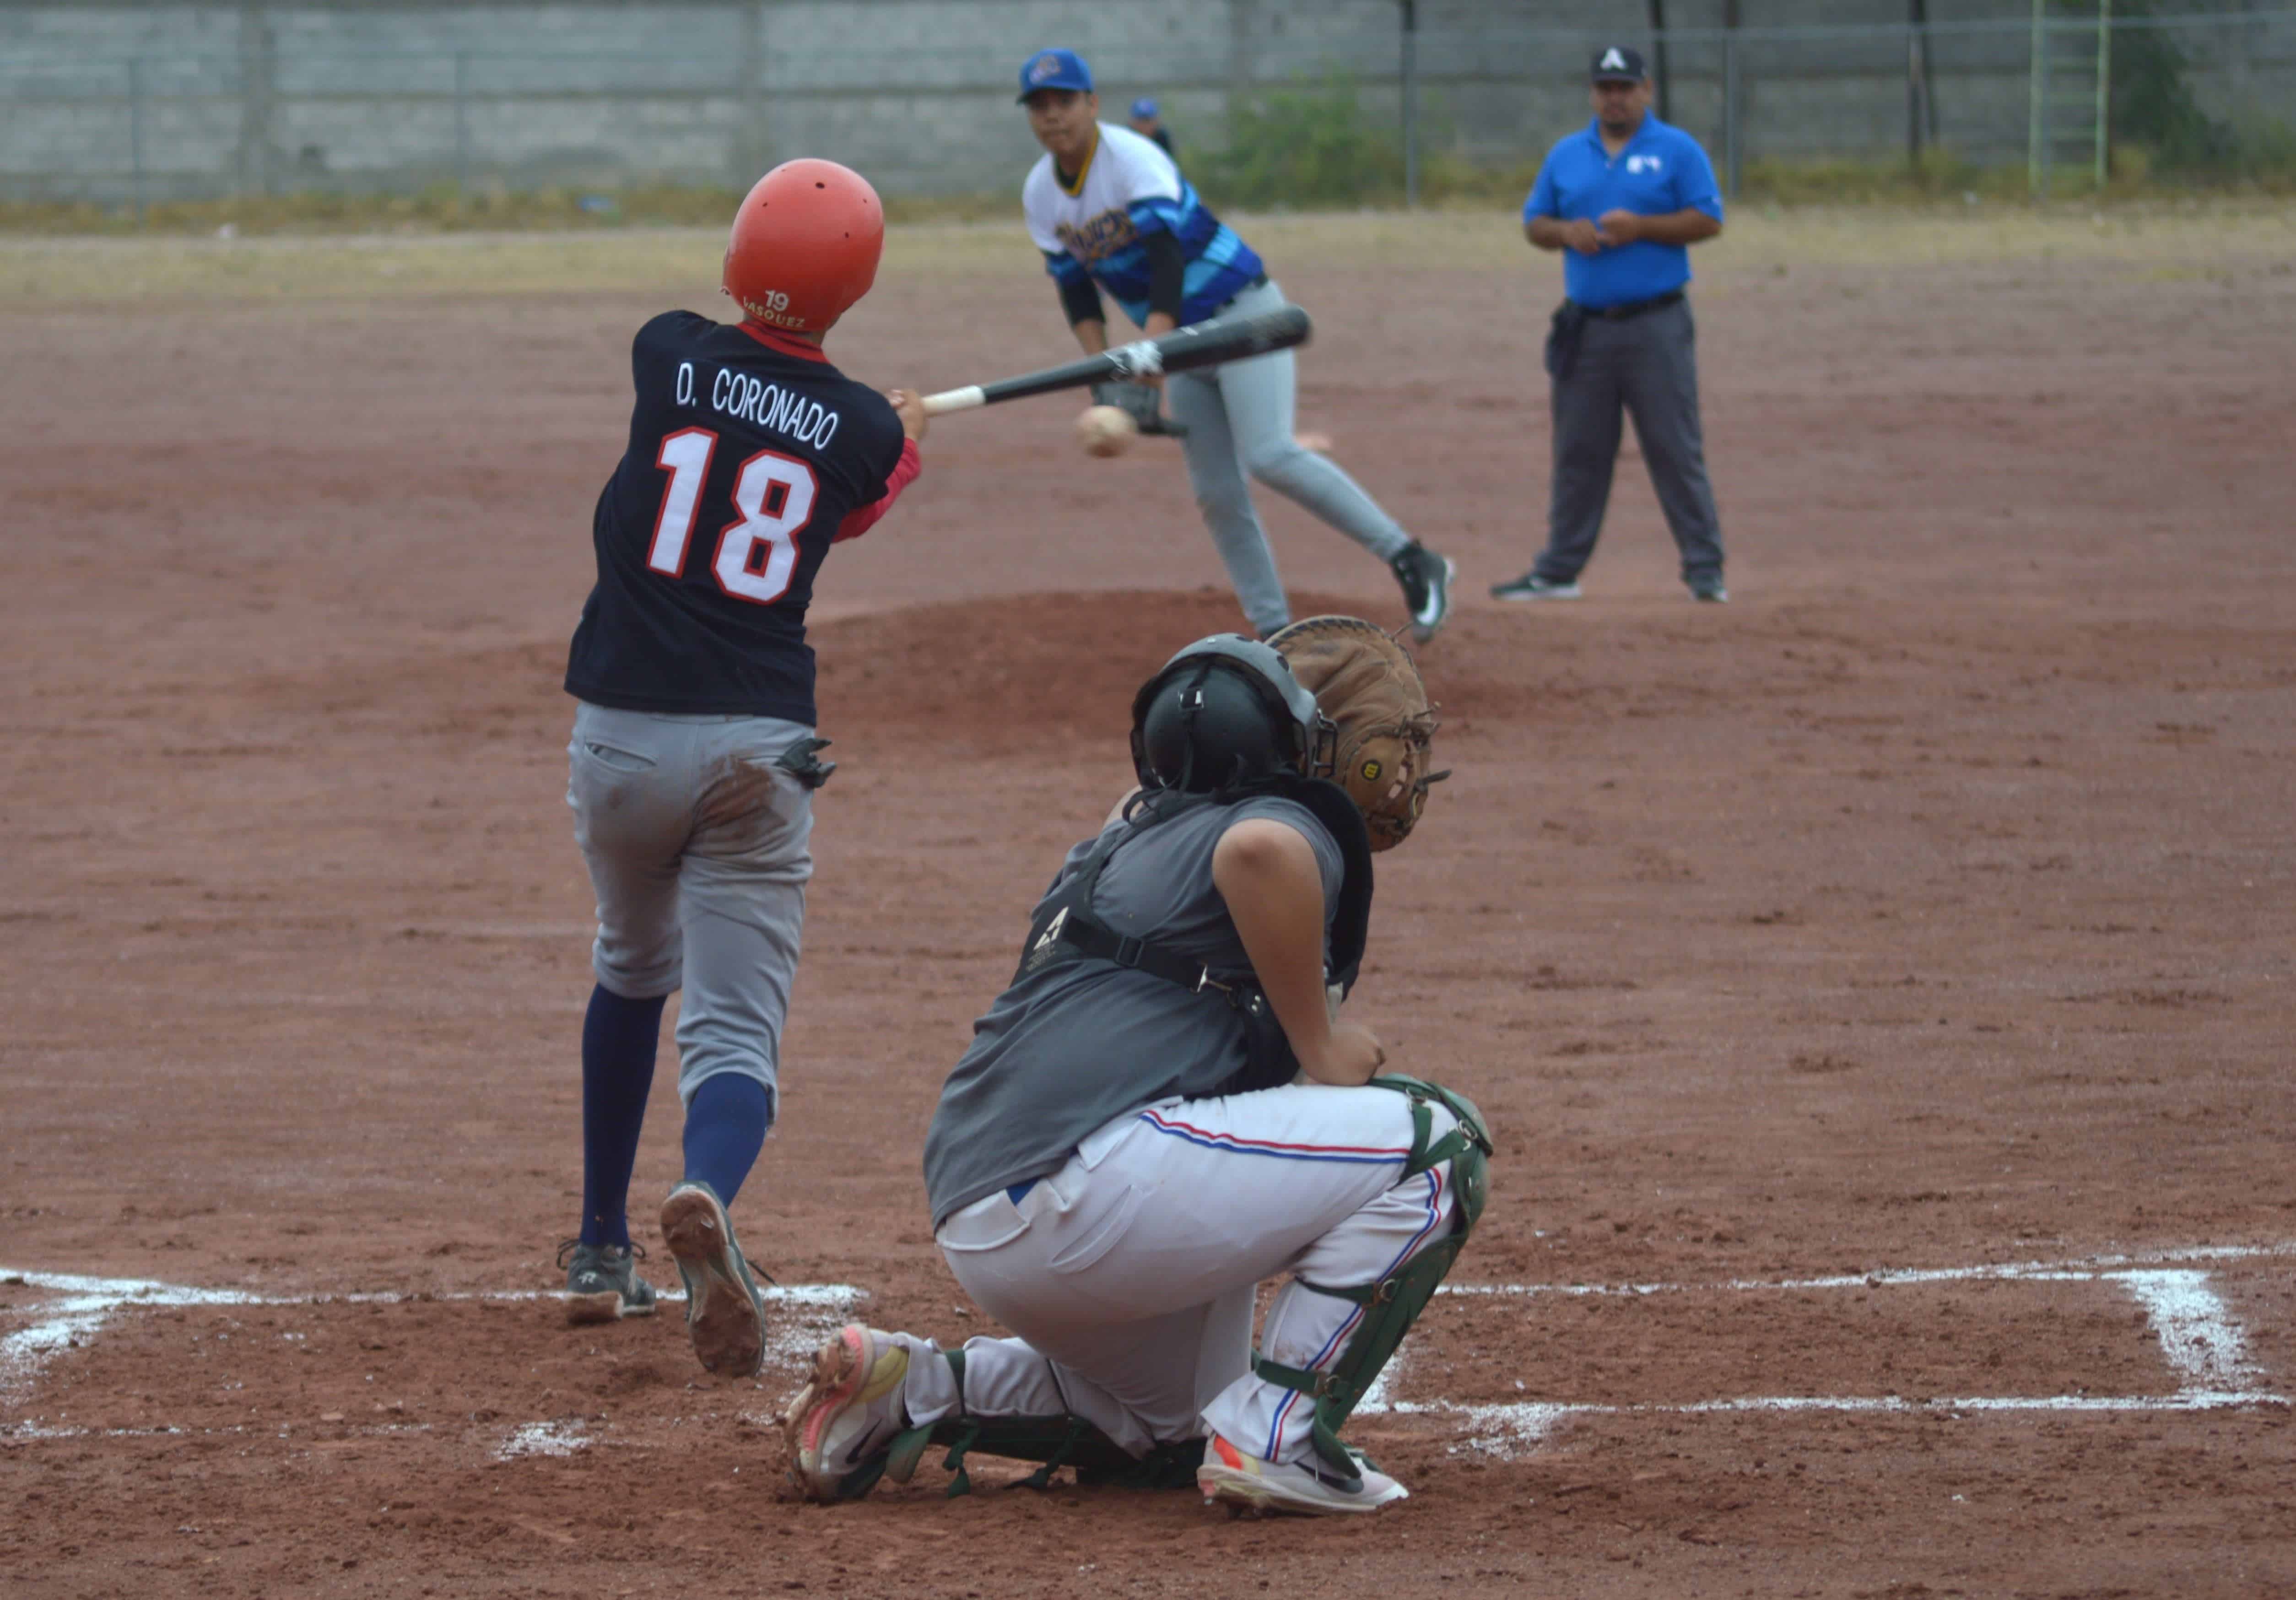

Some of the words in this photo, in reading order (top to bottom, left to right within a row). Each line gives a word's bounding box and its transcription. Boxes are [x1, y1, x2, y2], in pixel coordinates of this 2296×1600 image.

[765, 289, 789, 312] 19
[676, 362, 697, 407] D.
[713, 368, 838, 450] CORONADO
[646, 426, 819, 605] 18
